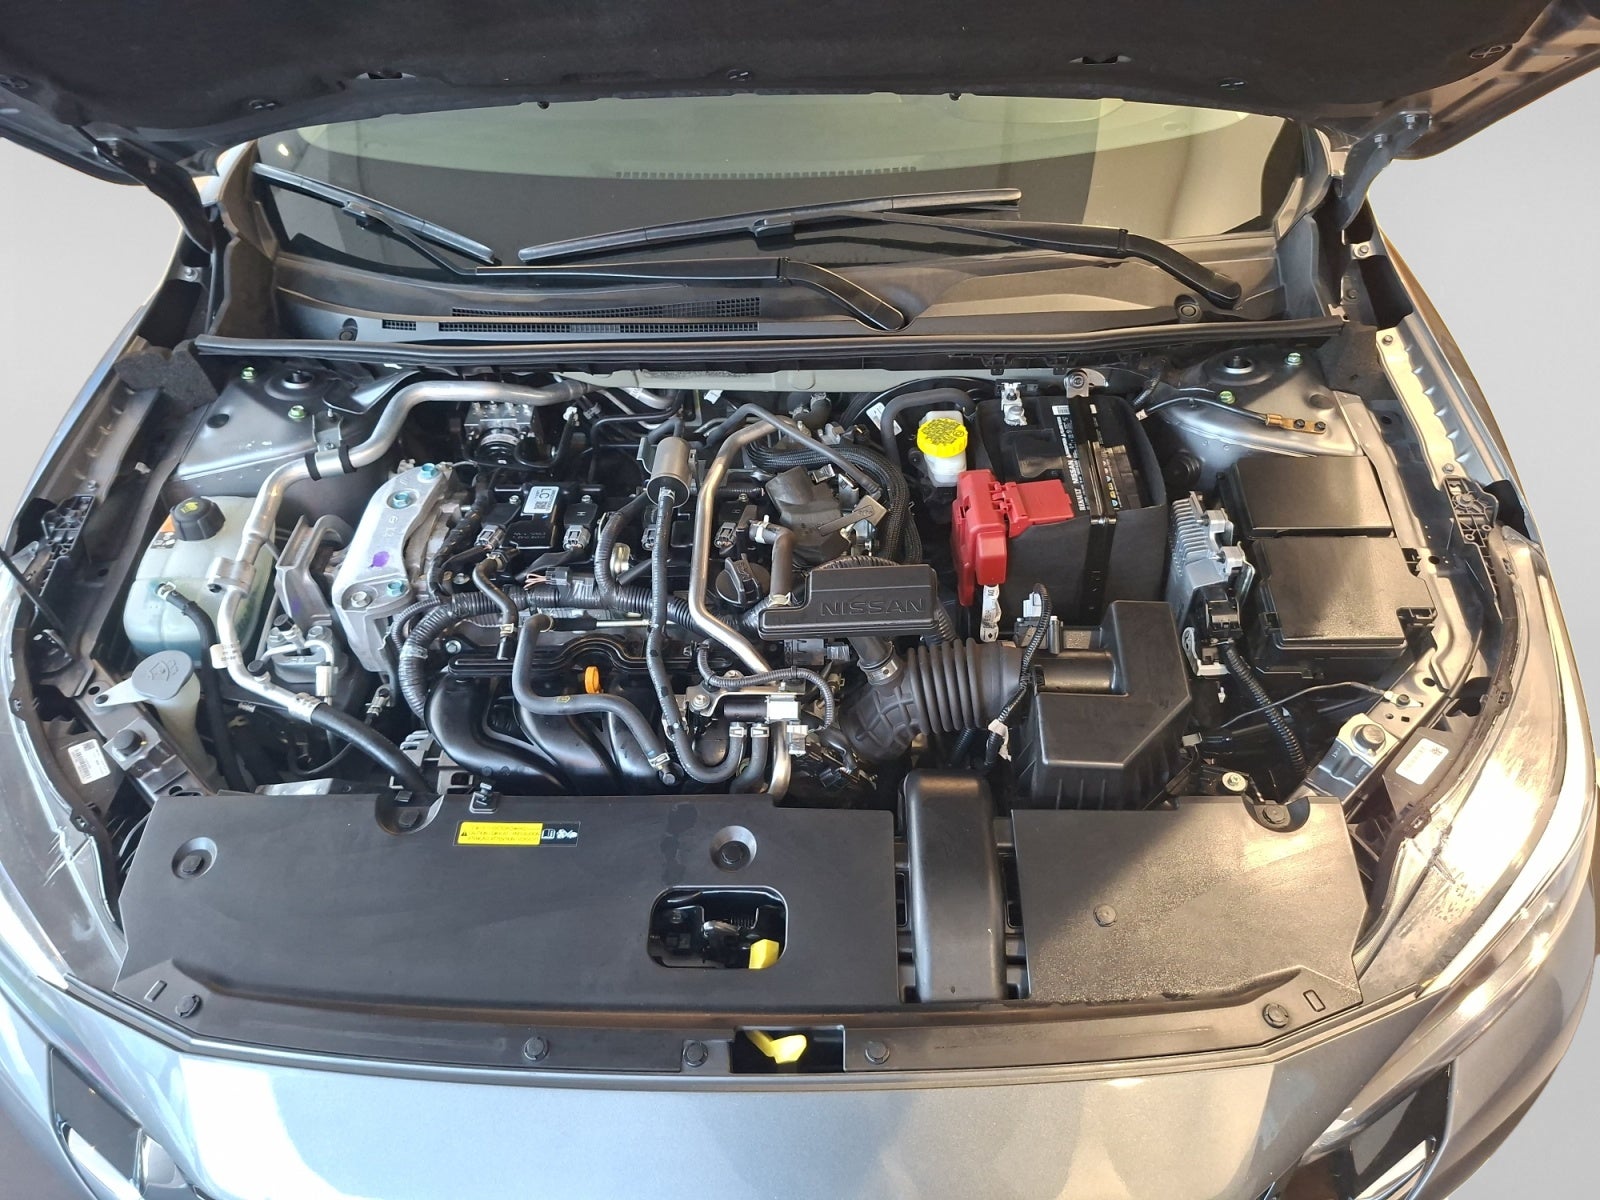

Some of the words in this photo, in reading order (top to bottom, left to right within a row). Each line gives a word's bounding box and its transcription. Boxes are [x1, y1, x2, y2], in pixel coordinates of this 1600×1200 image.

[1067, 459, 1079, 484] NISSAN
[1074, 488, 1087, 511] RENAULT
[820, 598, 923, 616] NISSAN
